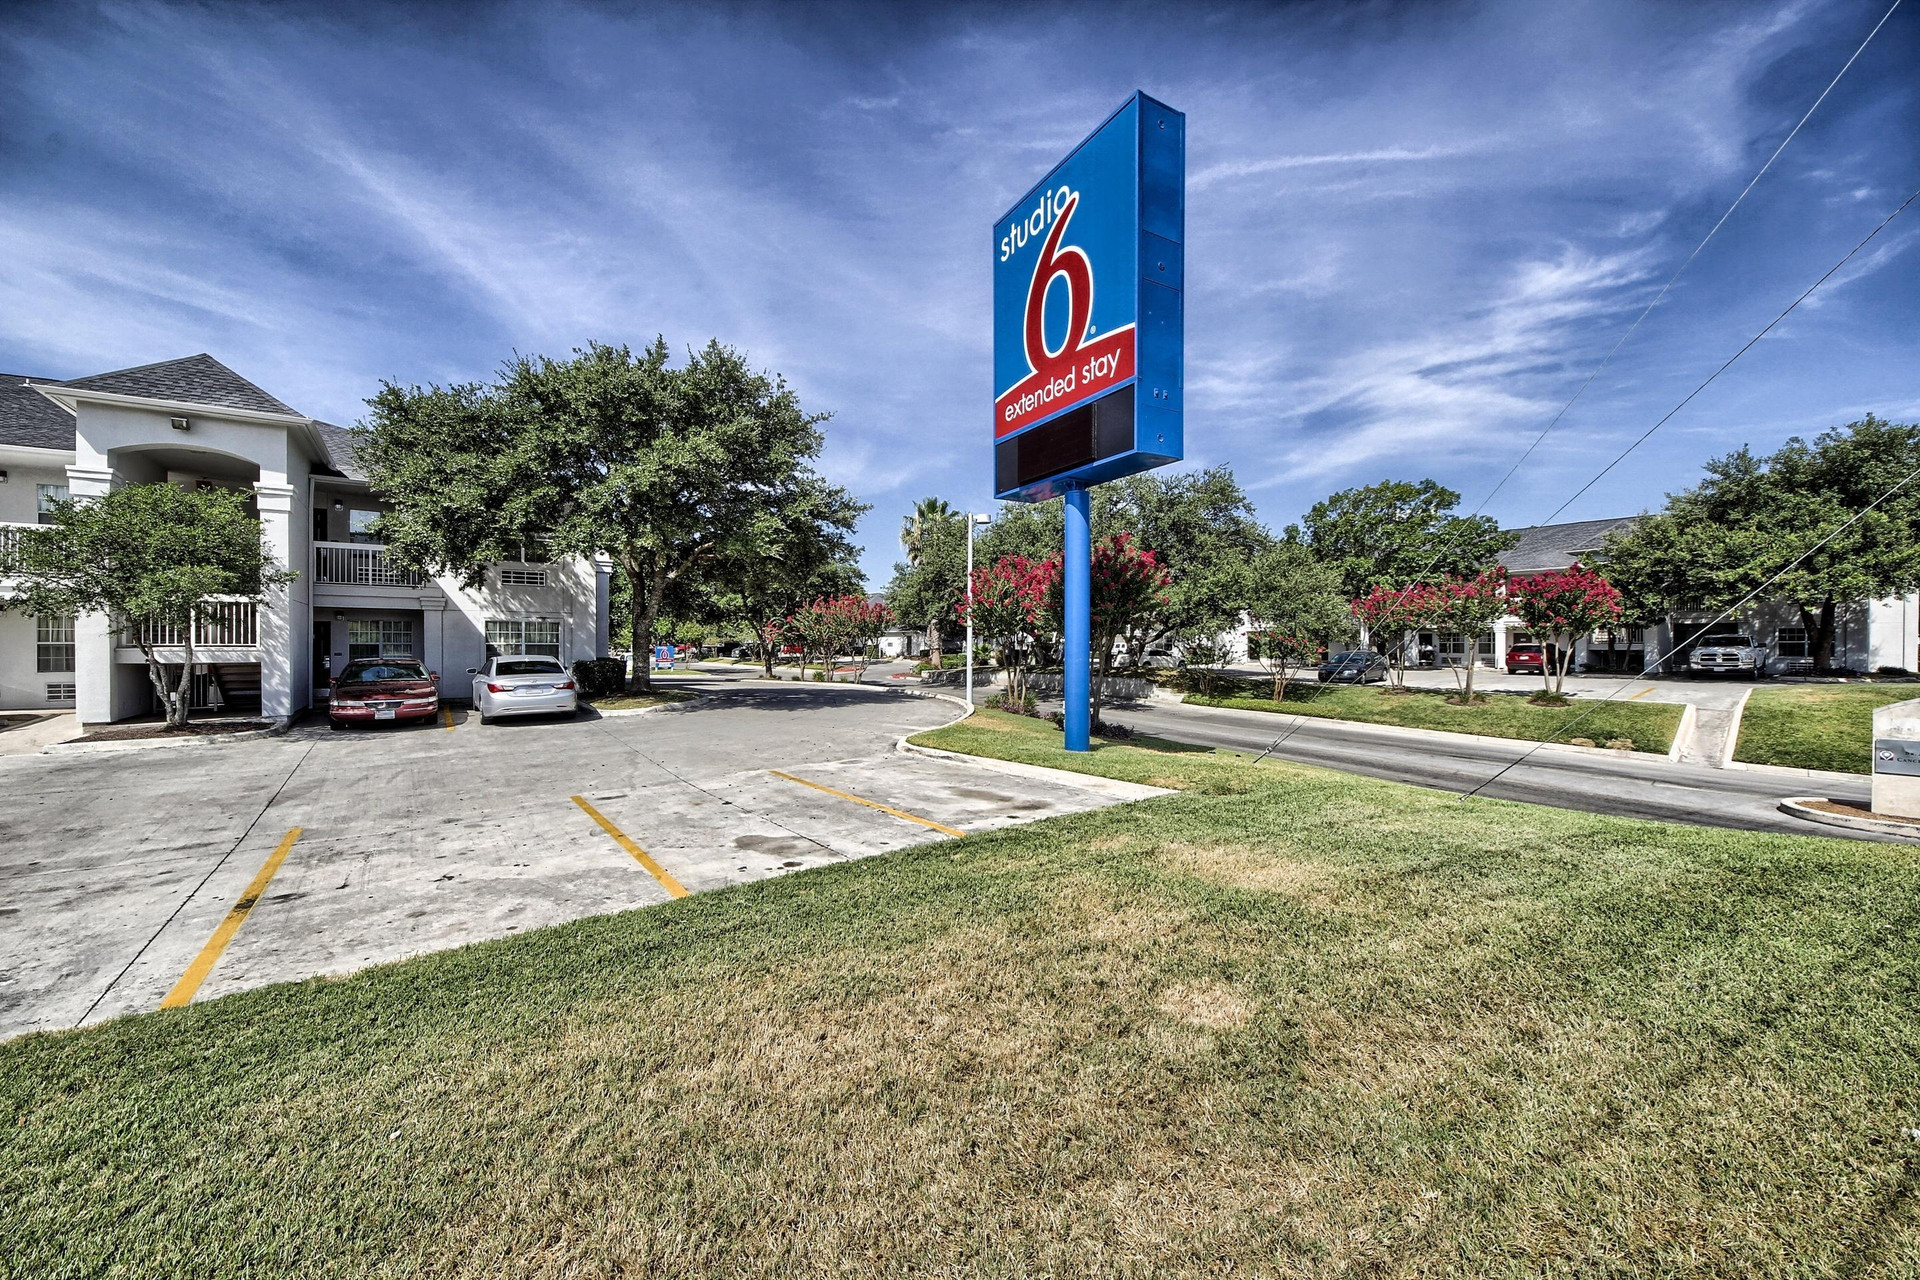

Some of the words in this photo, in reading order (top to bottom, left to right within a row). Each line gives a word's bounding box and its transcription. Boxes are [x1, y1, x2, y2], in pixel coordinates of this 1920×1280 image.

[1000, 185, 1071, 262] studio
[1023, 191, 1094, 373] 6
[1004, 366, 1076, 422] extended
[1081, 348, 1121, 384] stay
